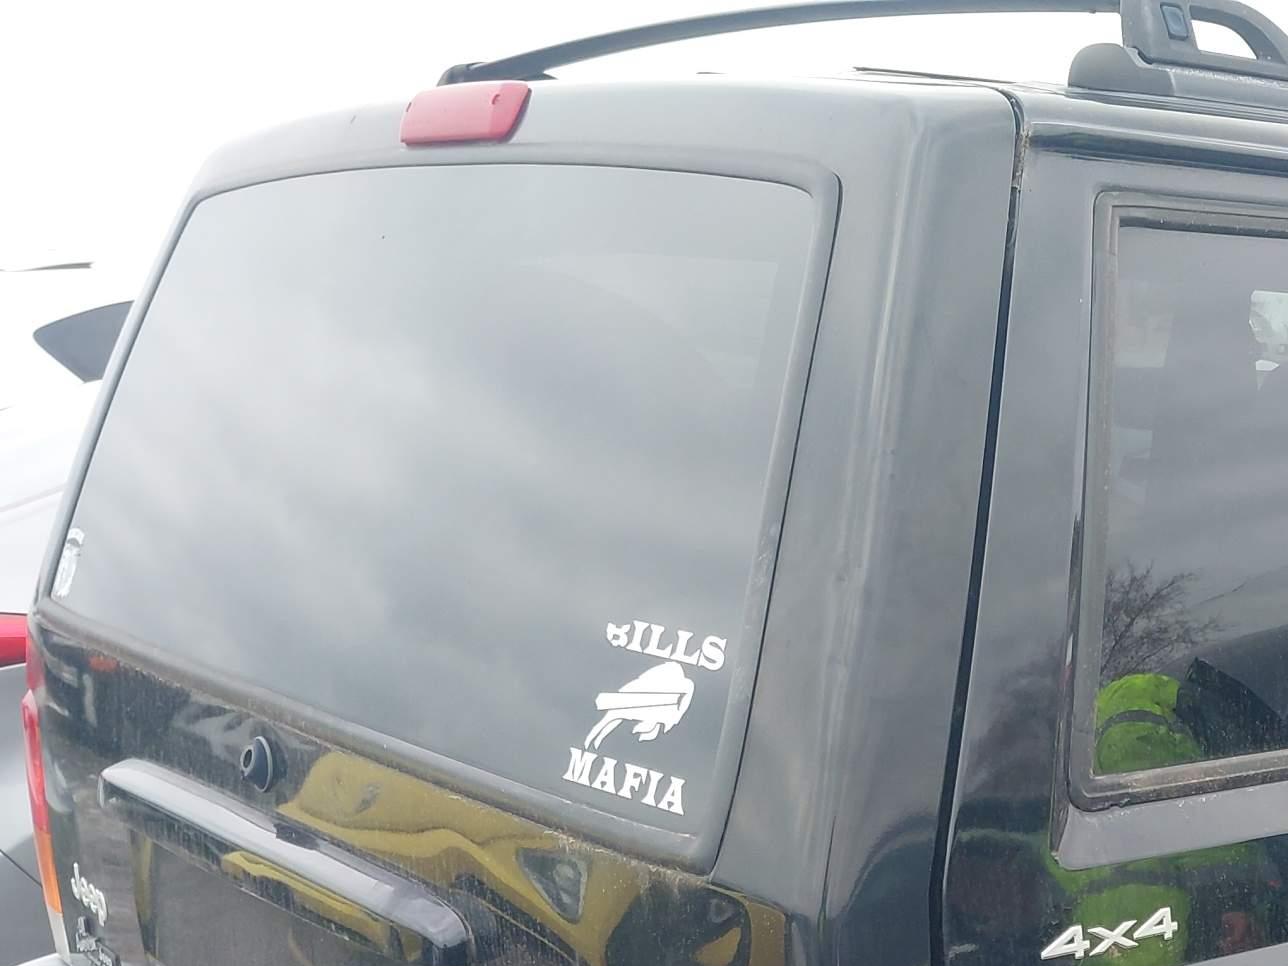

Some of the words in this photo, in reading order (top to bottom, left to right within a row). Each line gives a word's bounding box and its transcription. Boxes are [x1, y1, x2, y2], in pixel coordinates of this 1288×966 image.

[606, 619, 728, 671] BILLS
[562, 747, 686, 816] MAFIA
[70, 861, 108, 928] Jeep
